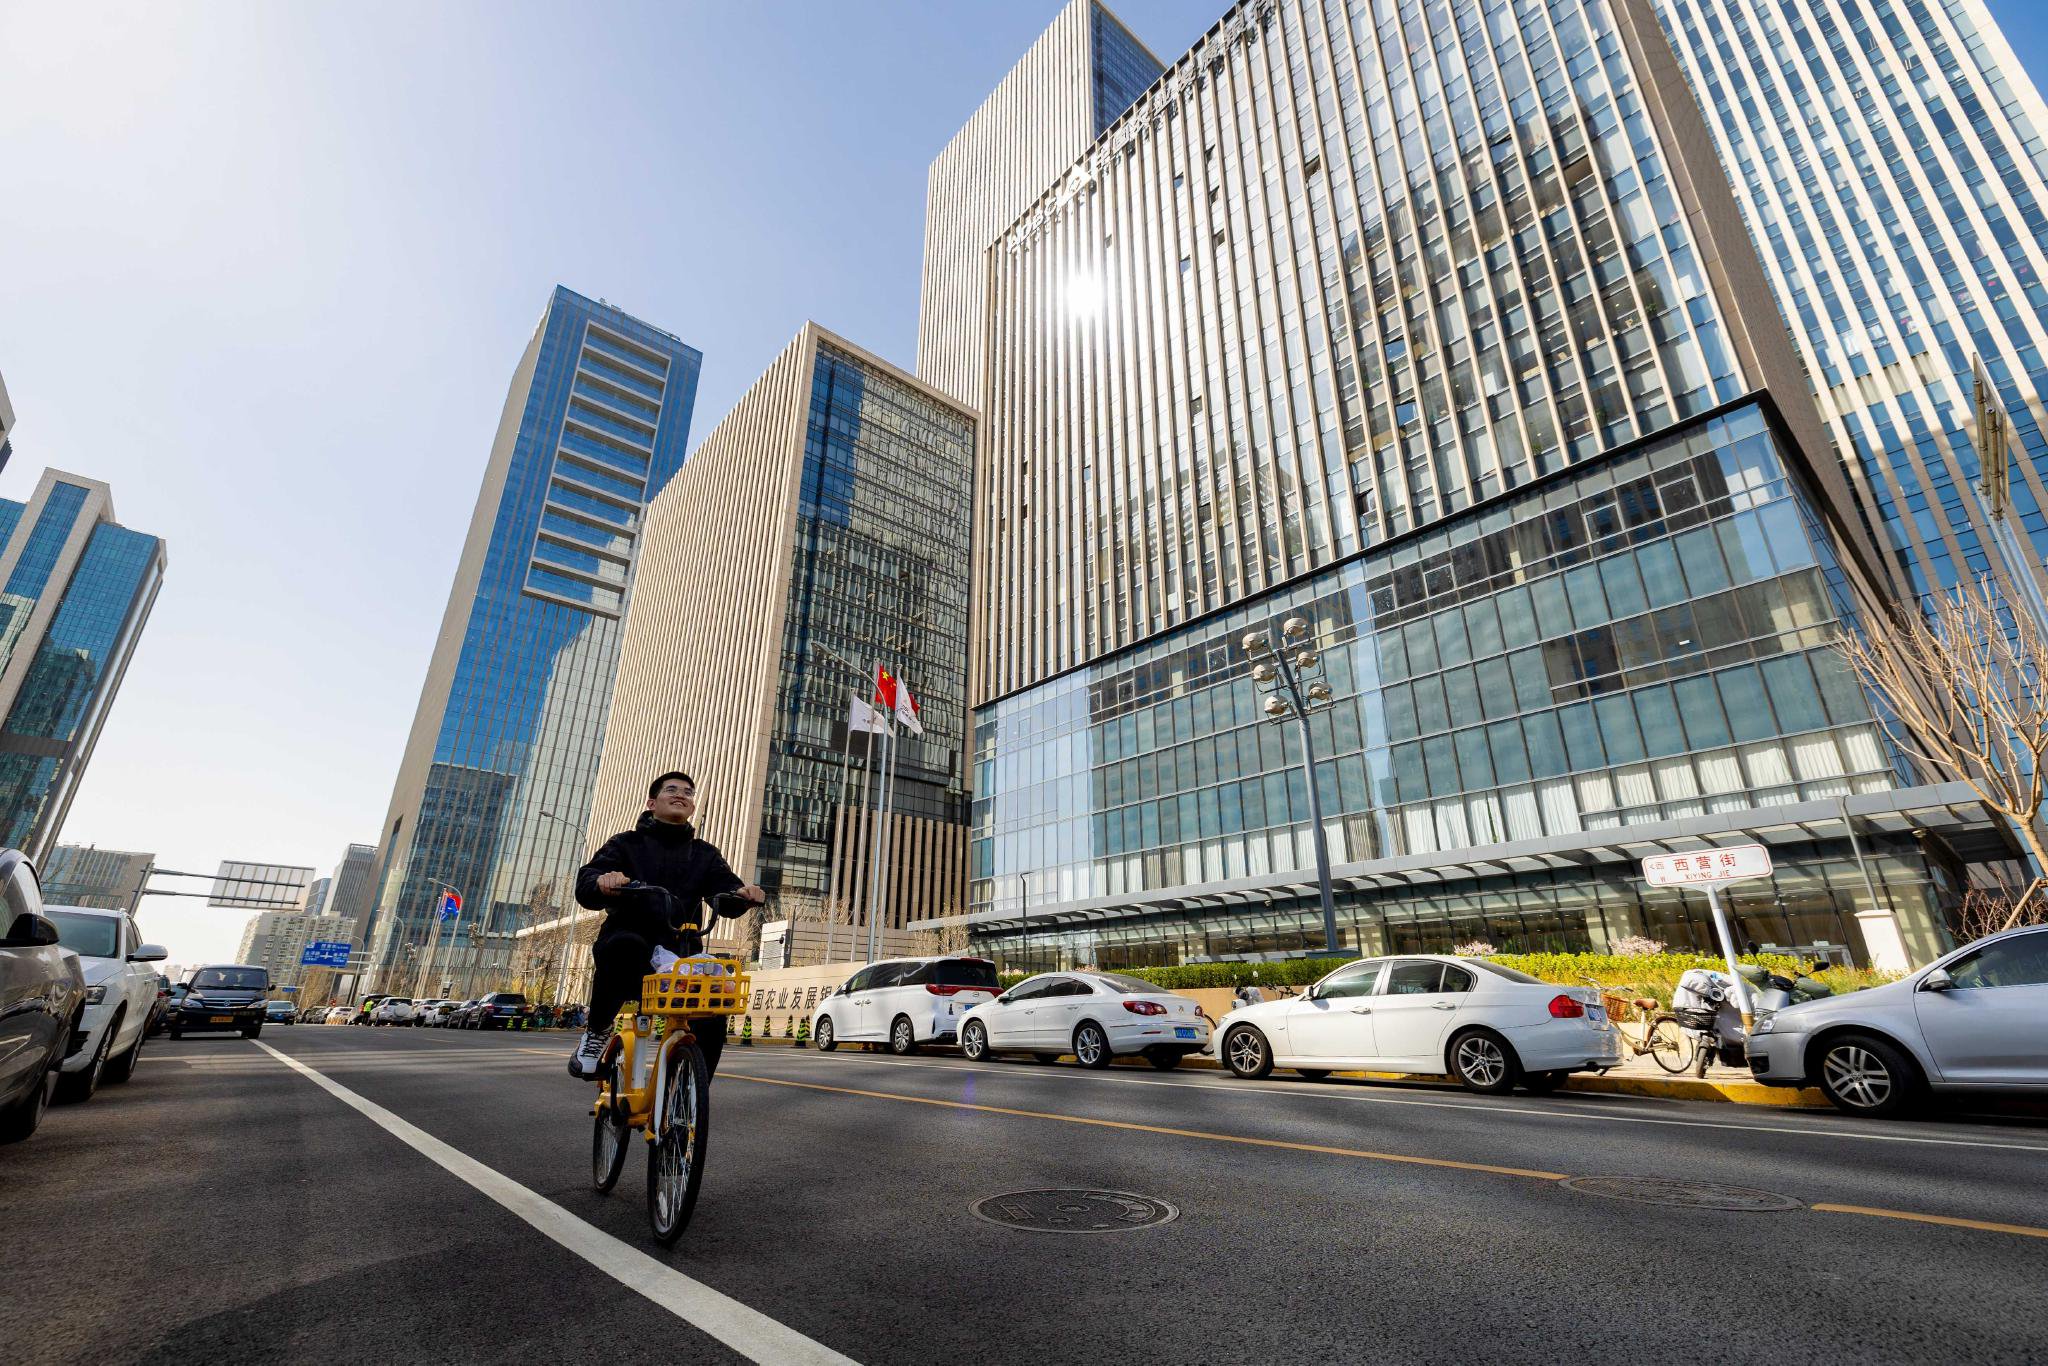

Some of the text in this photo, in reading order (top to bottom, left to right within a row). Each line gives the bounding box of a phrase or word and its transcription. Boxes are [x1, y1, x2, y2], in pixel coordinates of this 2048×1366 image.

[1673, 853, 1736, 871] 西营街
[1685, 871, 1713, 880] XIYING
[1718, 869, 1731, 878] JIE
[746, 984, 843, 1011] 国农业发展银
